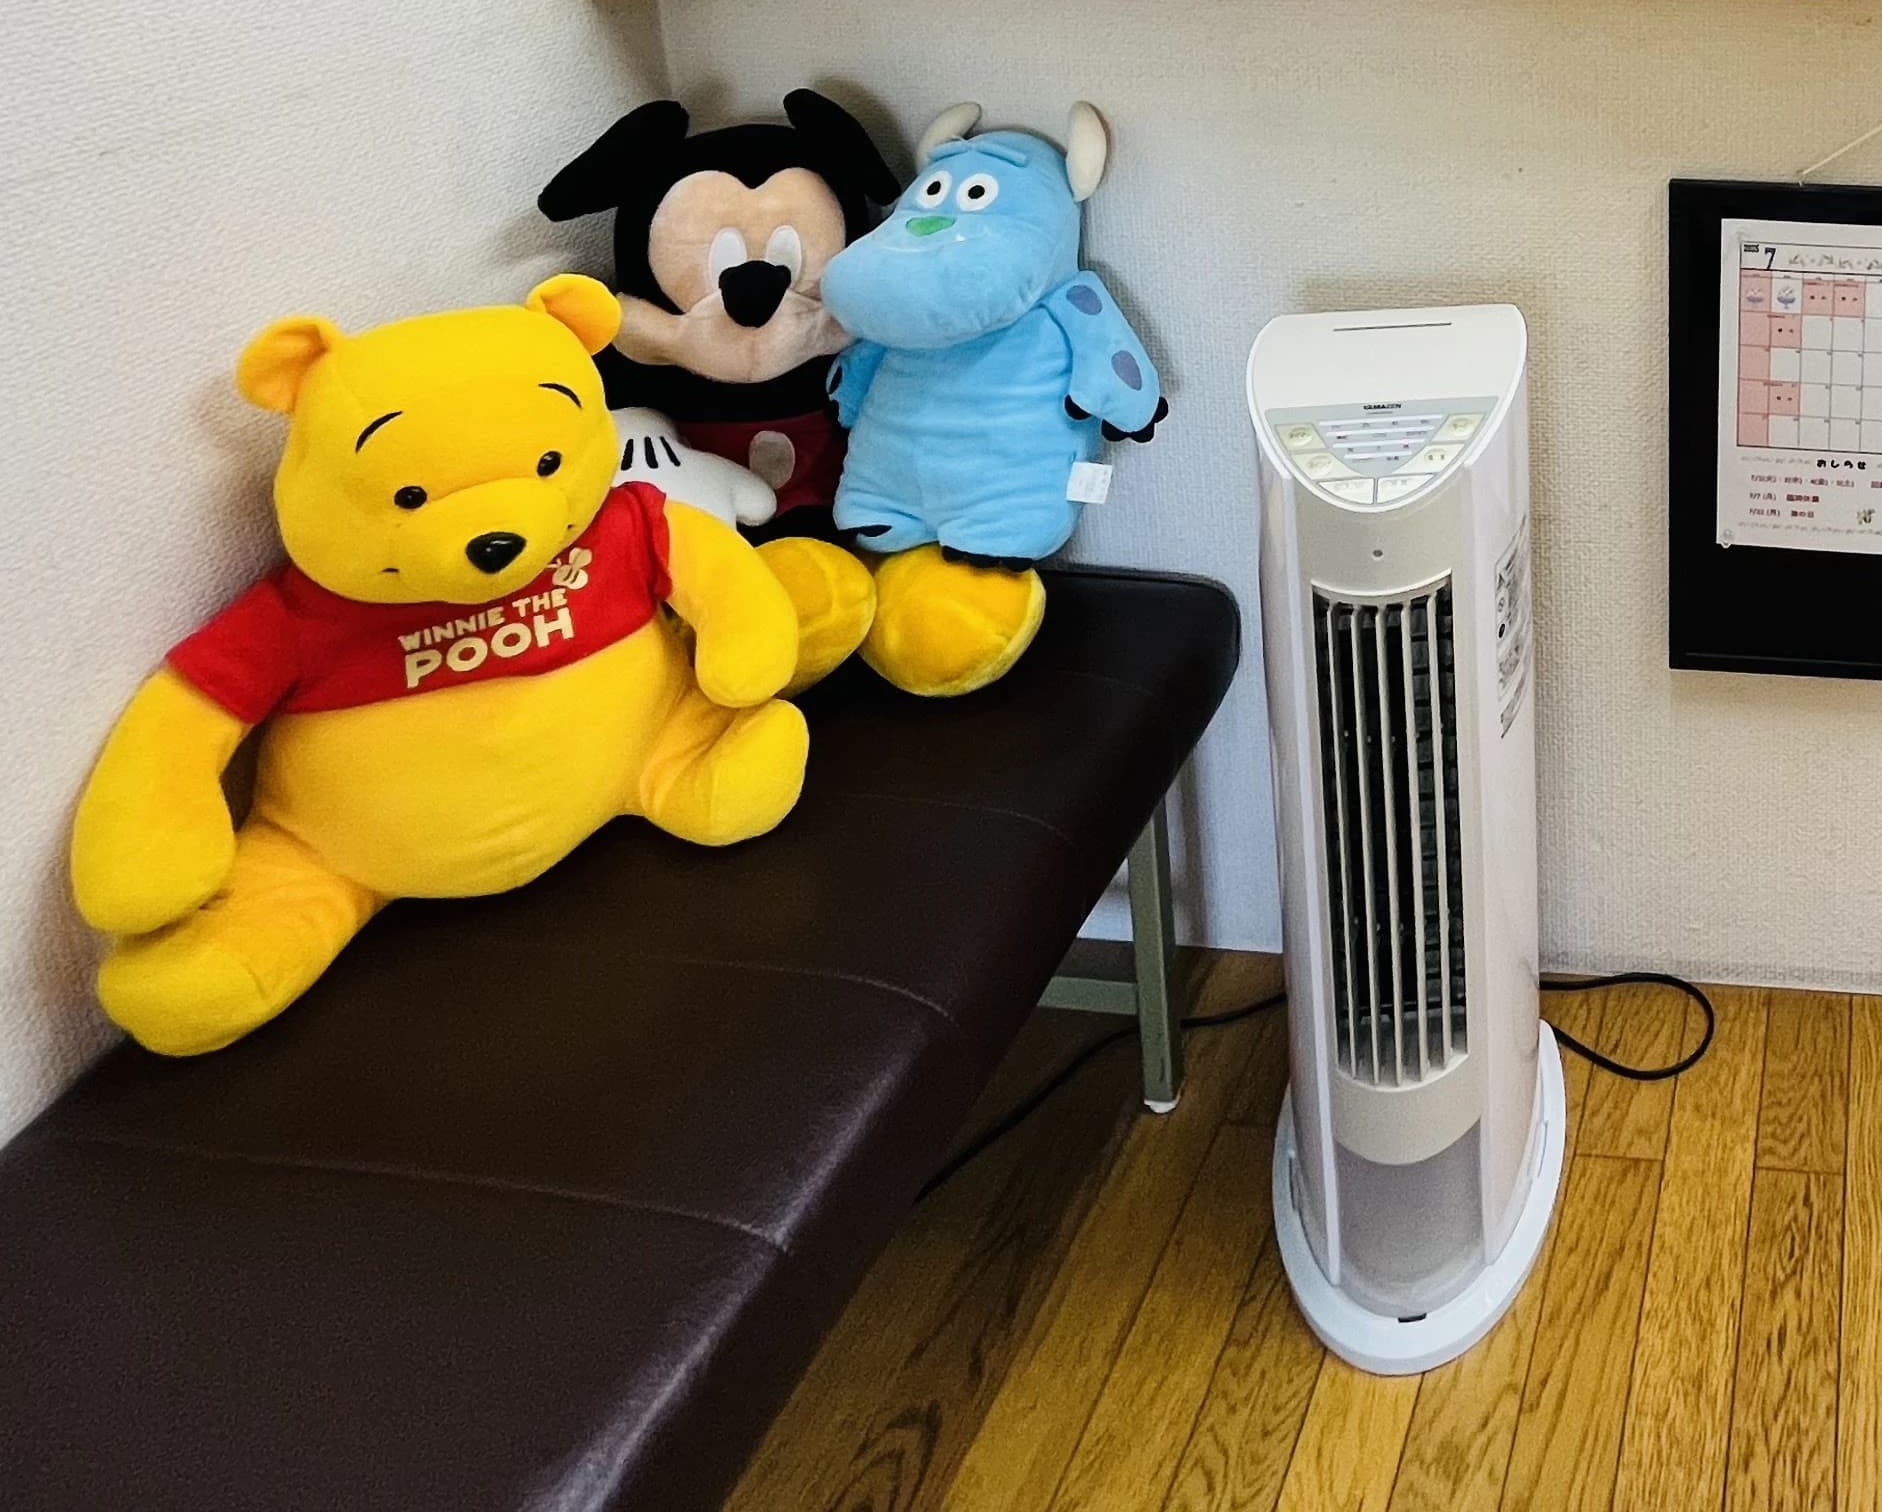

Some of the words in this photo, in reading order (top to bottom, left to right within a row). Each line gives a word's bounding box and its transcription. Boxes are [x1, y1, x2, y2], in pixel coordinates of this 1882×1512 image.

[1765, 247, 1776, 271] 7
[398, 606, 505, 652] WINNIE
[512, 588, 568, 618] THE
[404, 607, 575, 689] POOH
